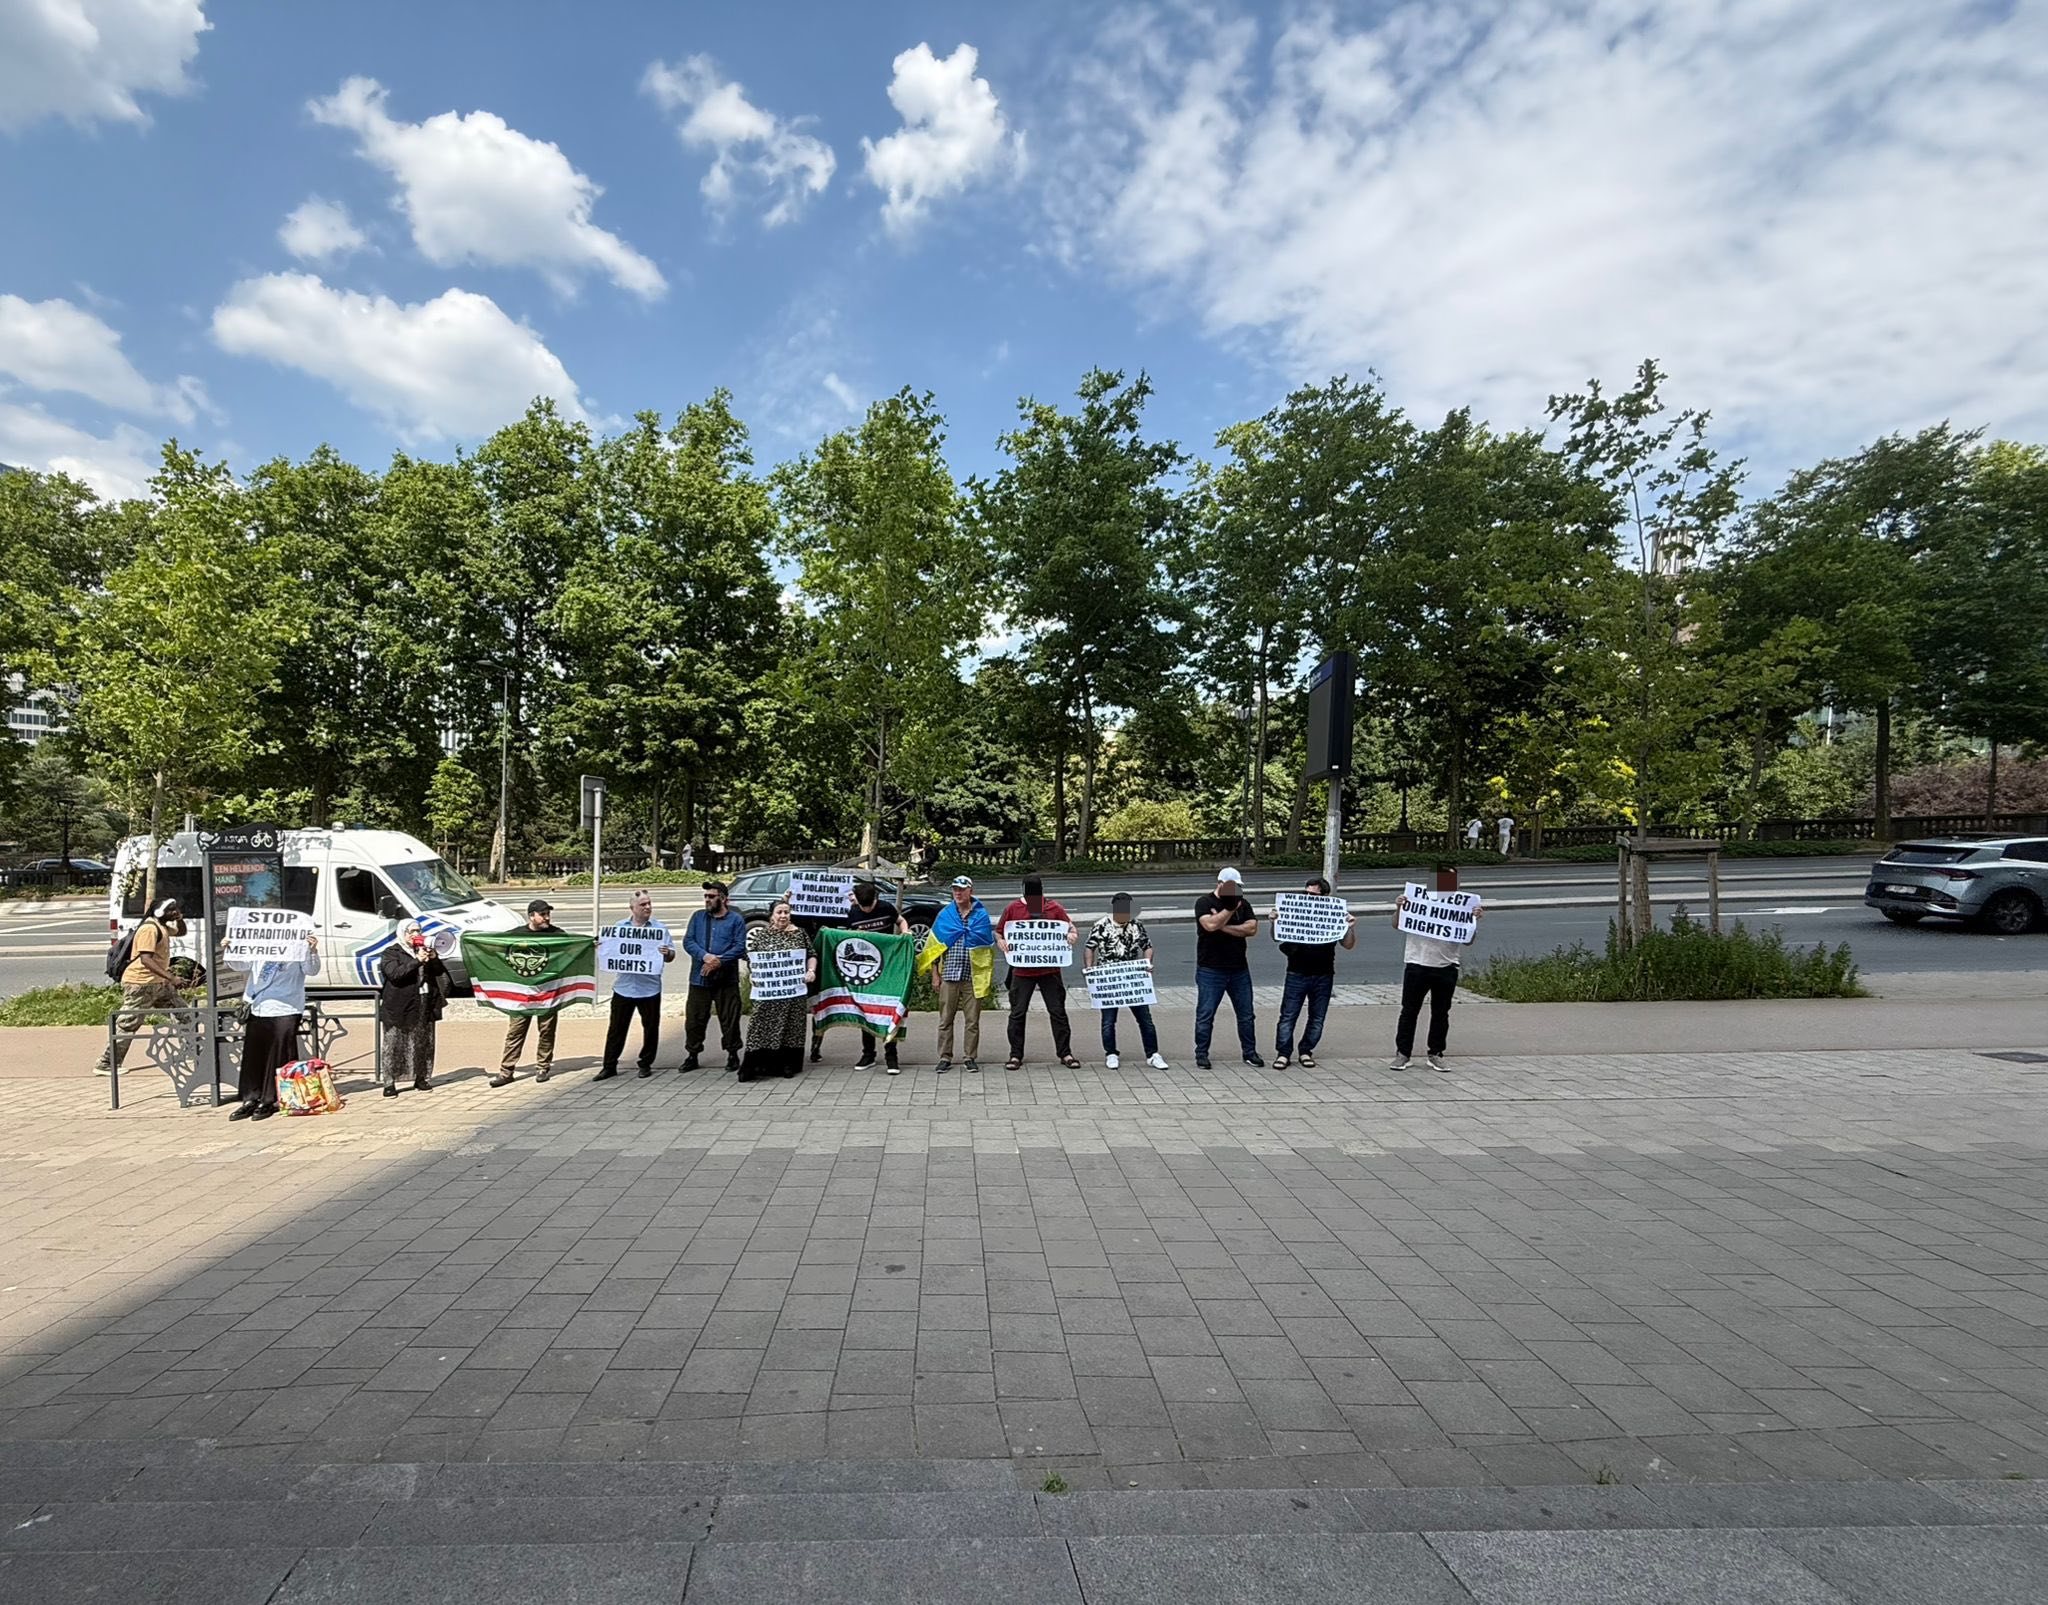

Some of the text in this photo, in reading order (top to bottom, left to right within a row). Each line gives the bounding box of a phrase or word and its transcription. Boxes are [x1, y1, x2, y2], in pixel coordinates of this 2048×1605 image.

[213, 864, 229, 873] EEN
[214, 875, 236, 884] HAND
[792, 872, 851, 884] WE ARE AGAINST
[802, 883, 840, 894] VIOLATION
[796, 893, 844, 904] OF RIGHTS OF
[1298, 895, 1330, 903] DEMAND
[1414, 886, 1471, 907] PRECT
[1281, 900, 1312, 908] RELEASE
[1279, 907, 1312, 915] MEYRIEV
[1402, 900, 1474, 924] OUR HUMAN
[247, 911, 298, 924] STOP
[1291, 914, 1337, 924] FABRICATED
[1015, 920, 1061, 930] STOP
[1277, 920, 1314, 928] CRIMINAL
[1404, 917, 1467, 940] RIGHTS !!!
[228, 927, 298, 940] L'EXTRADITION
[600, 926, 663, 941] WE DEMAND
[1007, 932, 1067, 941] PERSECUTION
[1296, 928, 1330, 936] REQUEST
[225, 946, 288, 955] MEYRIEV
[619, 942, 642, 955] OUR
[757, 952, 776, 960] STOP
[1012, 955, 1022, 963] IN
[1024, 955, 1058, 964] RUSSIA
[607, 958, 653, 973] RIGHTS !
[774, 968, 805, 978] SEEKERS
[766, 980, 781, 988] THE
